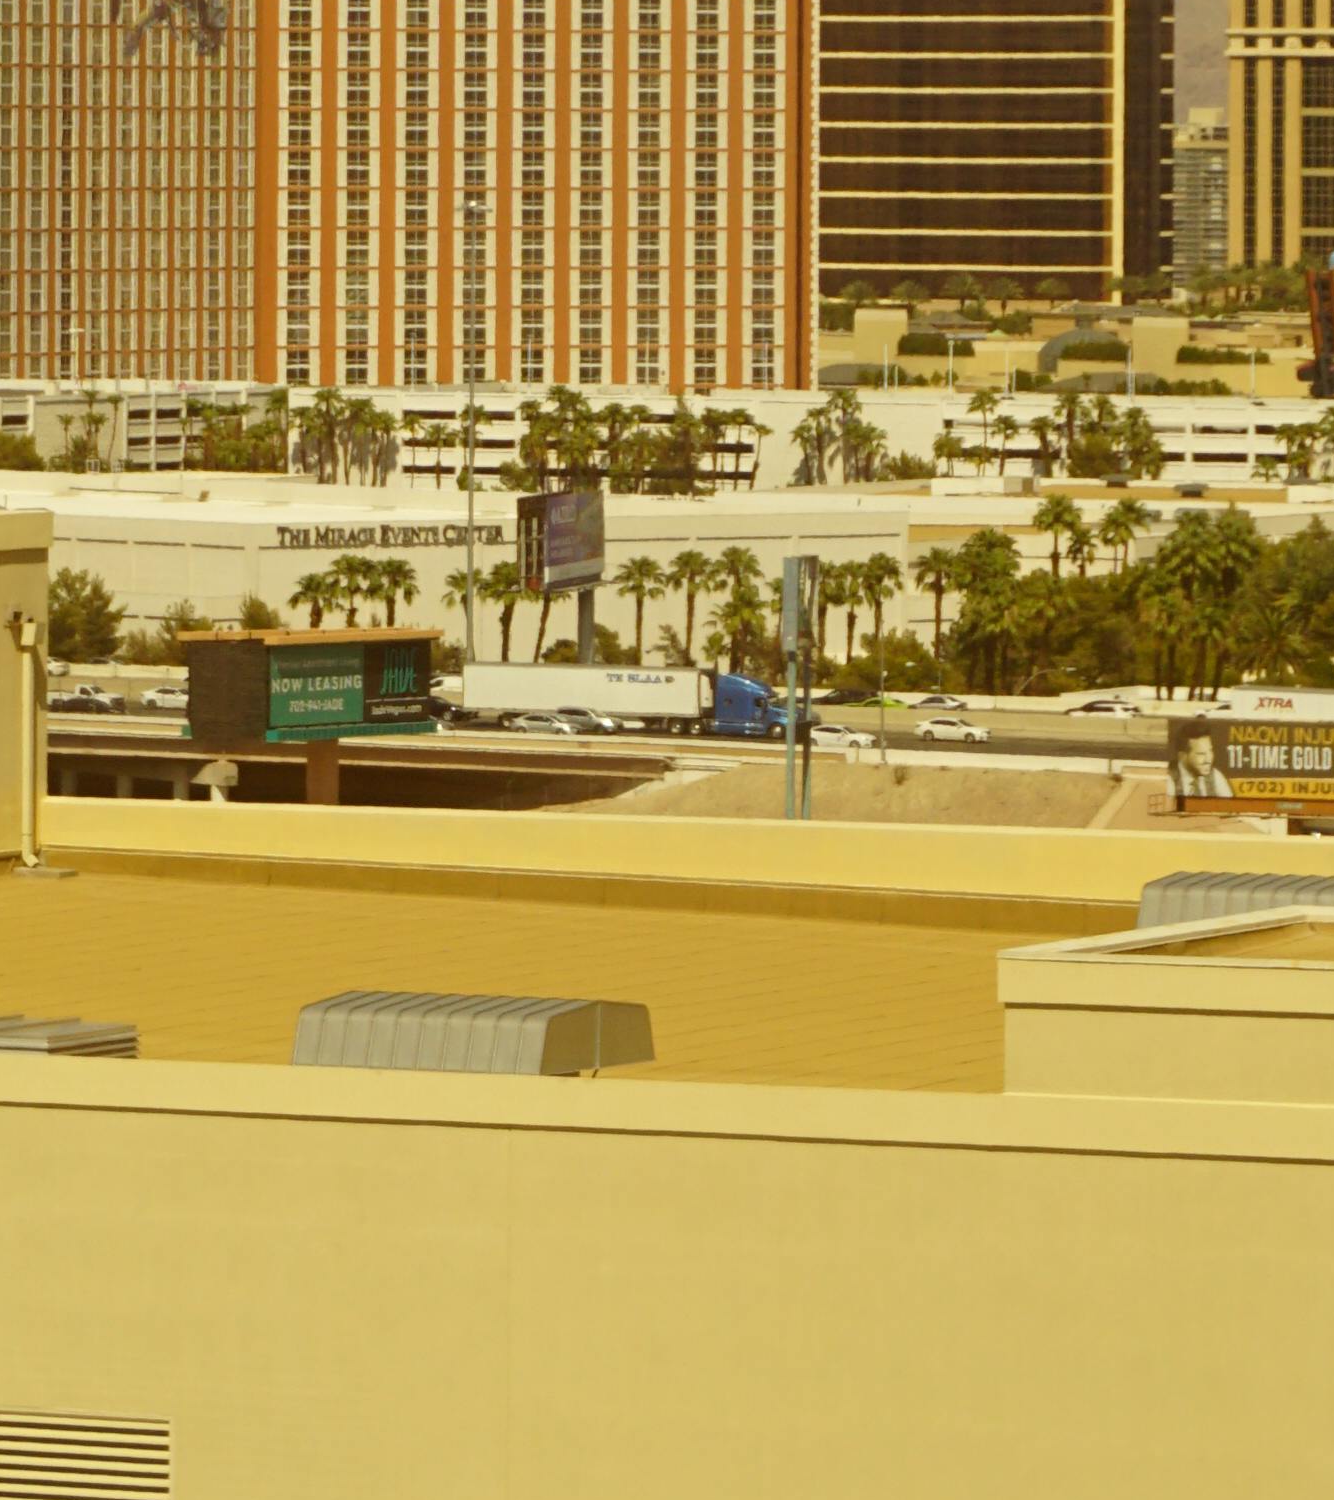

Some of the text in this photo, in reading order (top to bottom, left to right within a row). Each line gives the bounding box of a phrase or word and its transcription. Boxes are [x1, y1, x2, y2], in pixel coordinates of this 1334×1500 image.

[277, 526, 311, 547] THE
[315, 525, 376, 547] MIRAGE
[380, 524, 439, 547] EVENTS
[271, 674, 363, 693] NOW LEASING
[1254, 697, 1294, 711] XTRA
[1226, 745, 1289, 769] 11-TIME
[1291, 746, 1332, 770] GOLD
[1238, 779, 1285, 795] (702)
